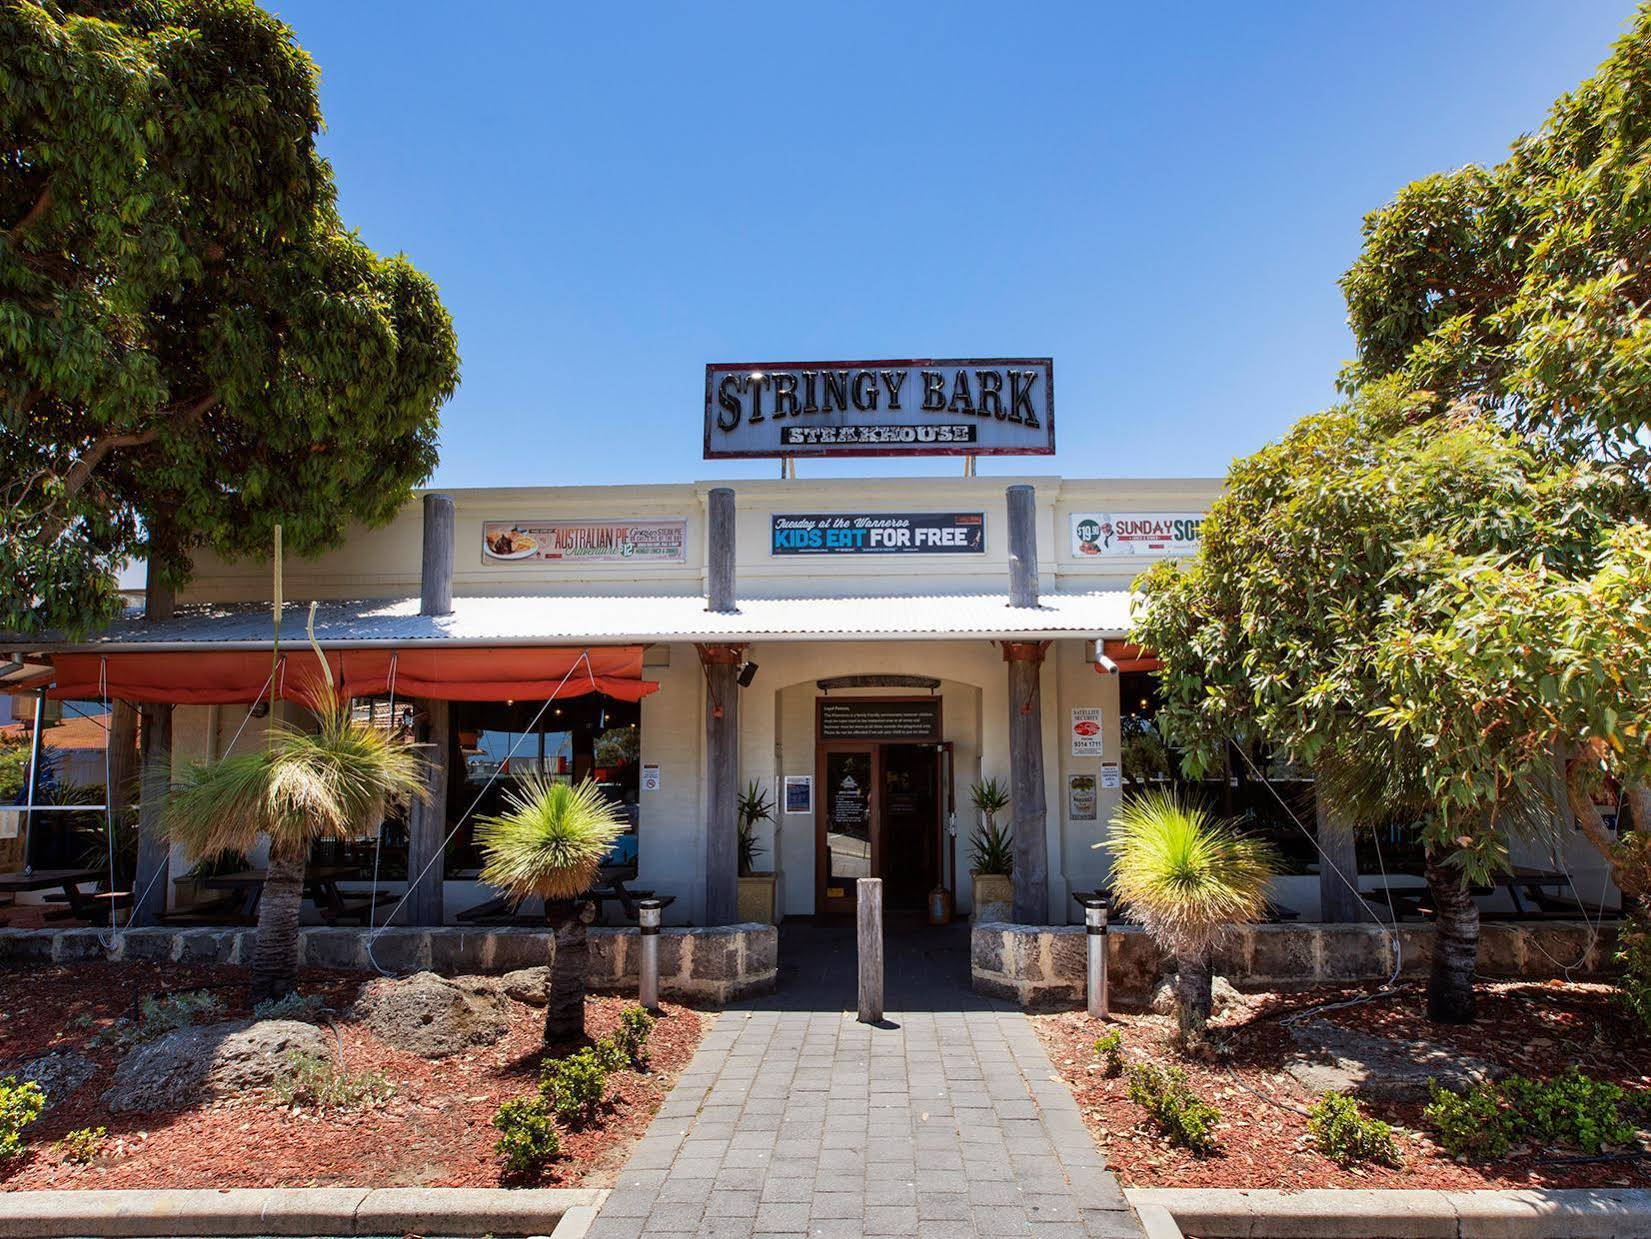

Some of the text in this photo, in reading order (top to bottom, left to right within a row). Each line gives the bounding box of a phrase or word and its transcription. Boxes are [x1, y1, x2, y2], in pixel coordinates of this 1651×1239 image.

[717, 369, 1040, 432] STRINGY BARK
[788, 425, 969, 444] STEAKHOUSE
[775, 517, 910, 530] Tuesday at the Wanneroo
[1116, 520, 1173, 535] SUNDAY
[555, 527, 614, 549] AUSTRALIAN
[615, 527, 629, 548] PIE
[775, 529, 822, 547] KIDS
[826, 528, 867, 547] EAT
[870, 528, 910, 547] FOR
